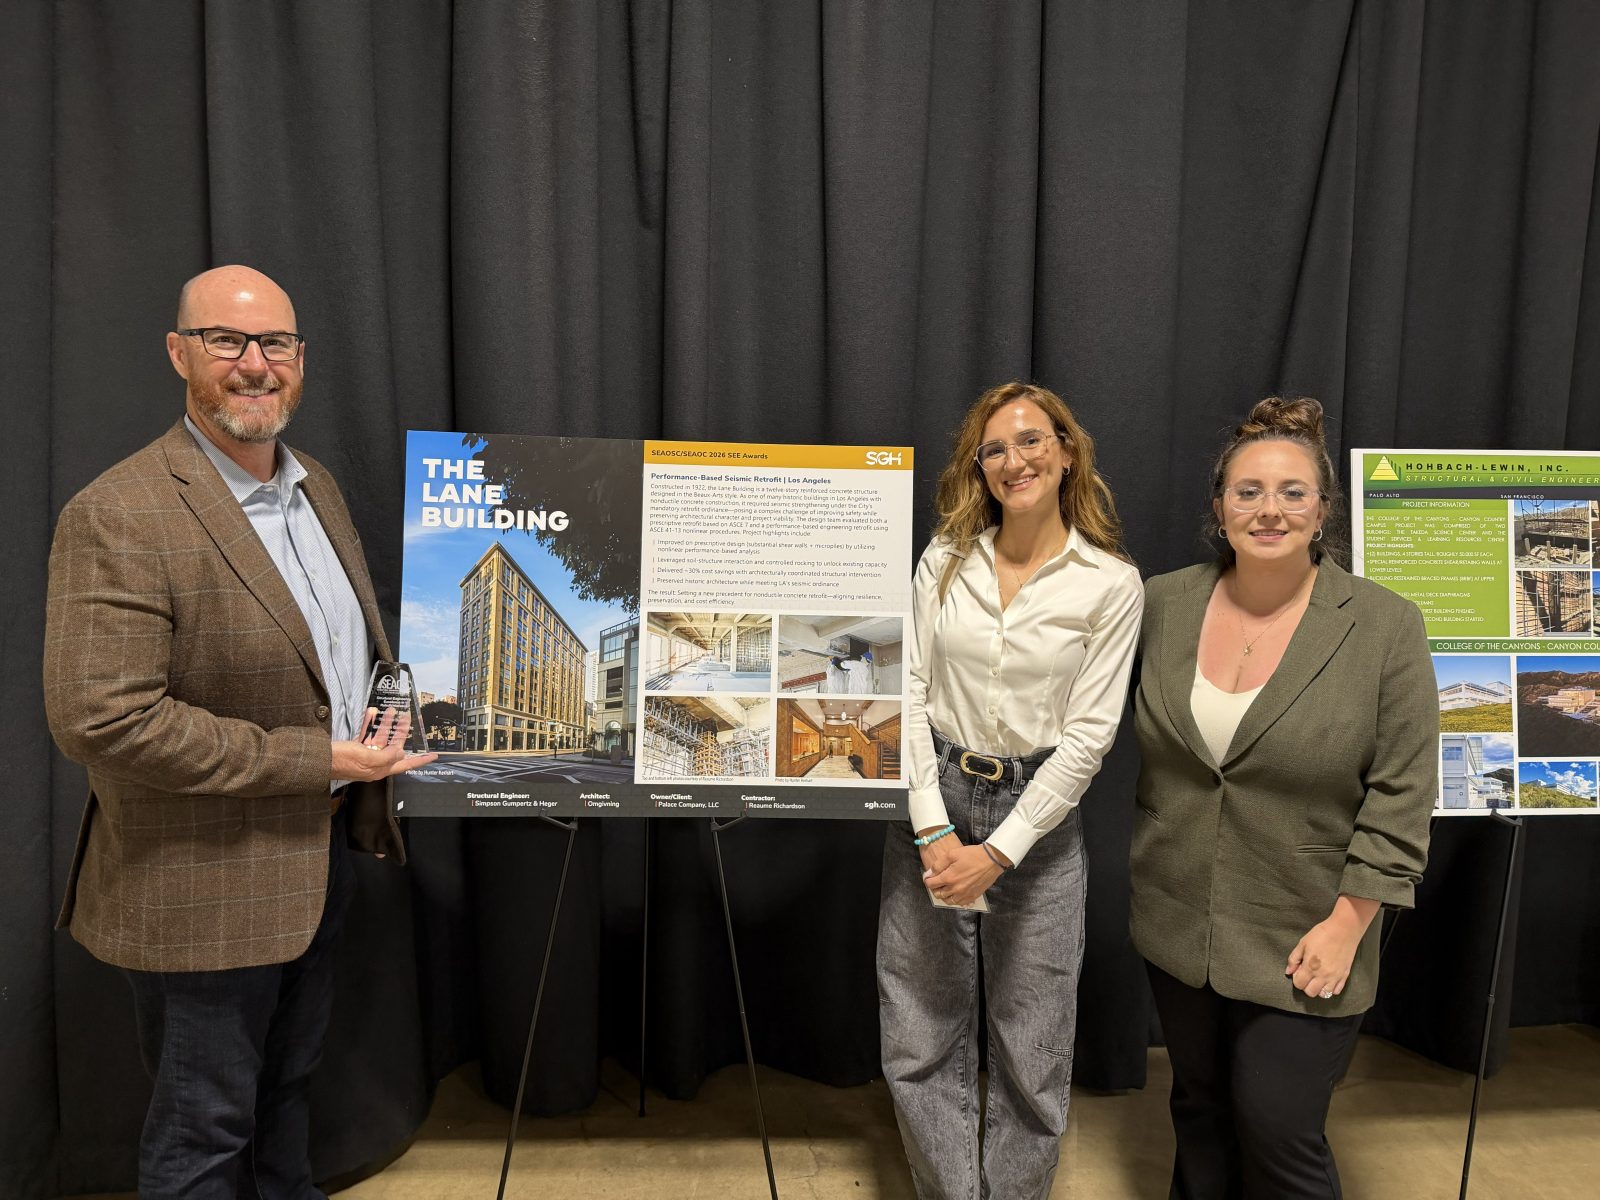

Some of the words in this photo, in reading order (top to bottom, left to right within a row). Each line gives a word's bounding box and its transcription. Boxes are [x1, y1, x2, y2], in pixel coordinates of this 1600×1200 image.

[866, 451, 902, 466] SGH
[423, 458, 485, 480] THE
[1406, 463, 1531, 472] HOHBACH-LEWIN,
[1540, 464, 1569, 472] INC.
[651, 473, 723, 481] Performance-Based
[753, 475, 782, 483] Retrofit
[802, 476, 831, 485] Angeles
[423, 482, 503, 505] LANE
[422, 506, 570, 532] BUILDING
[1436, 642, 1473, 650] COLLEGE
[1474, 642, 1486, 650] OF
[1486, 642, 1500, 650] THE
[1502, 642, 1541, 650] CANYONS
[500, 792, 530, 800] Engineer:
[475, 800, 501, 808] Simpson
[502, 800, 532, 808] Gumpertz
[588, 800, 620, 808] Omgivning
[864, 801, 896, 810] sgh.com
